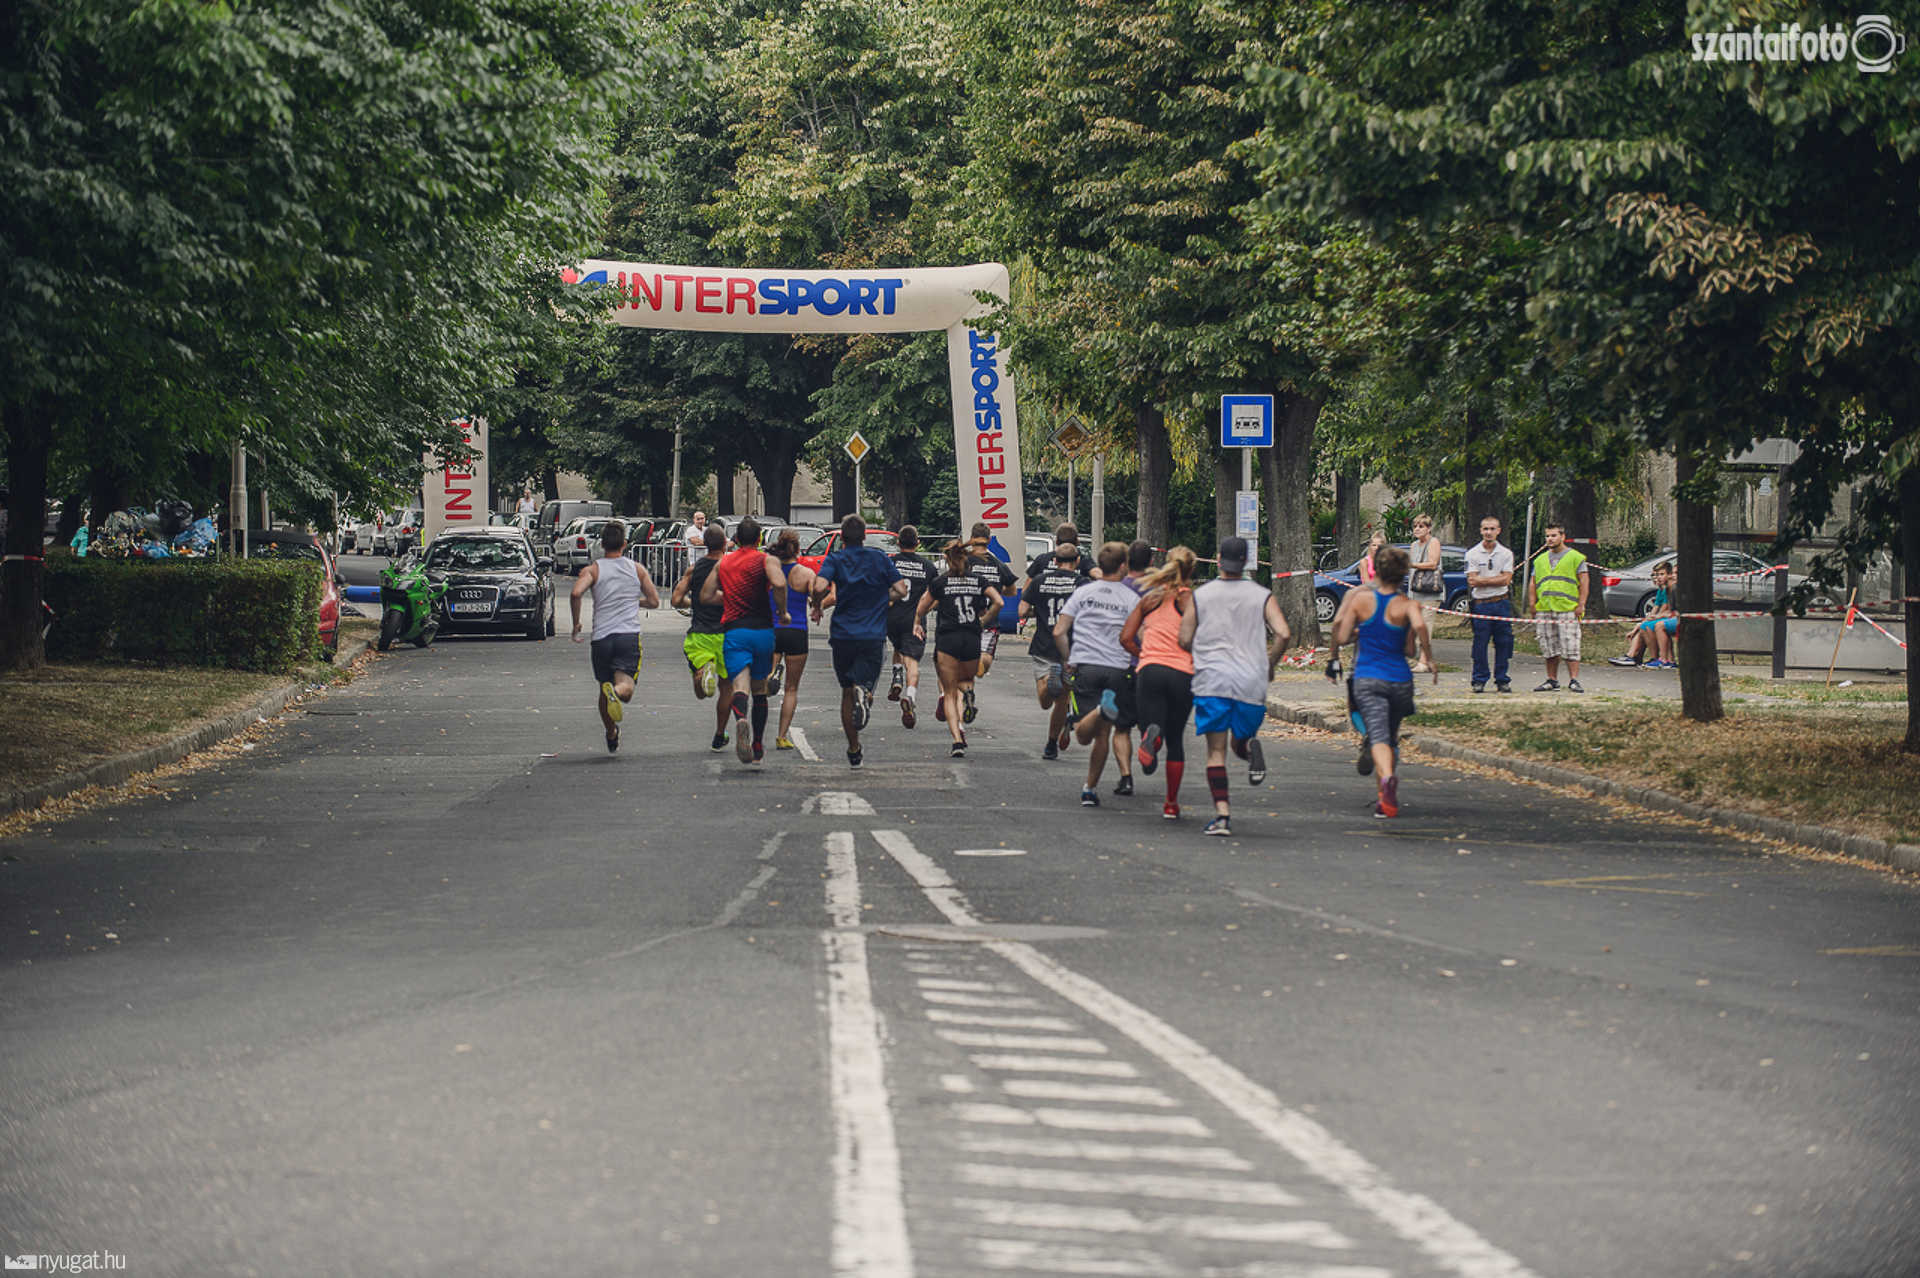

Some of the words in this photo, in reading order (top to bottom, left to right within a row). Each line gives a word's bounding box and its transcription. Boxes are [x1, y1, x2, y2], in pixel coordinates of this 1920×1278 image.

[617, 271, 903, 316] INTERSPORT
[968, 329, 1009, 529] INTERSPORT
[954, 595, 976, 624] 15
